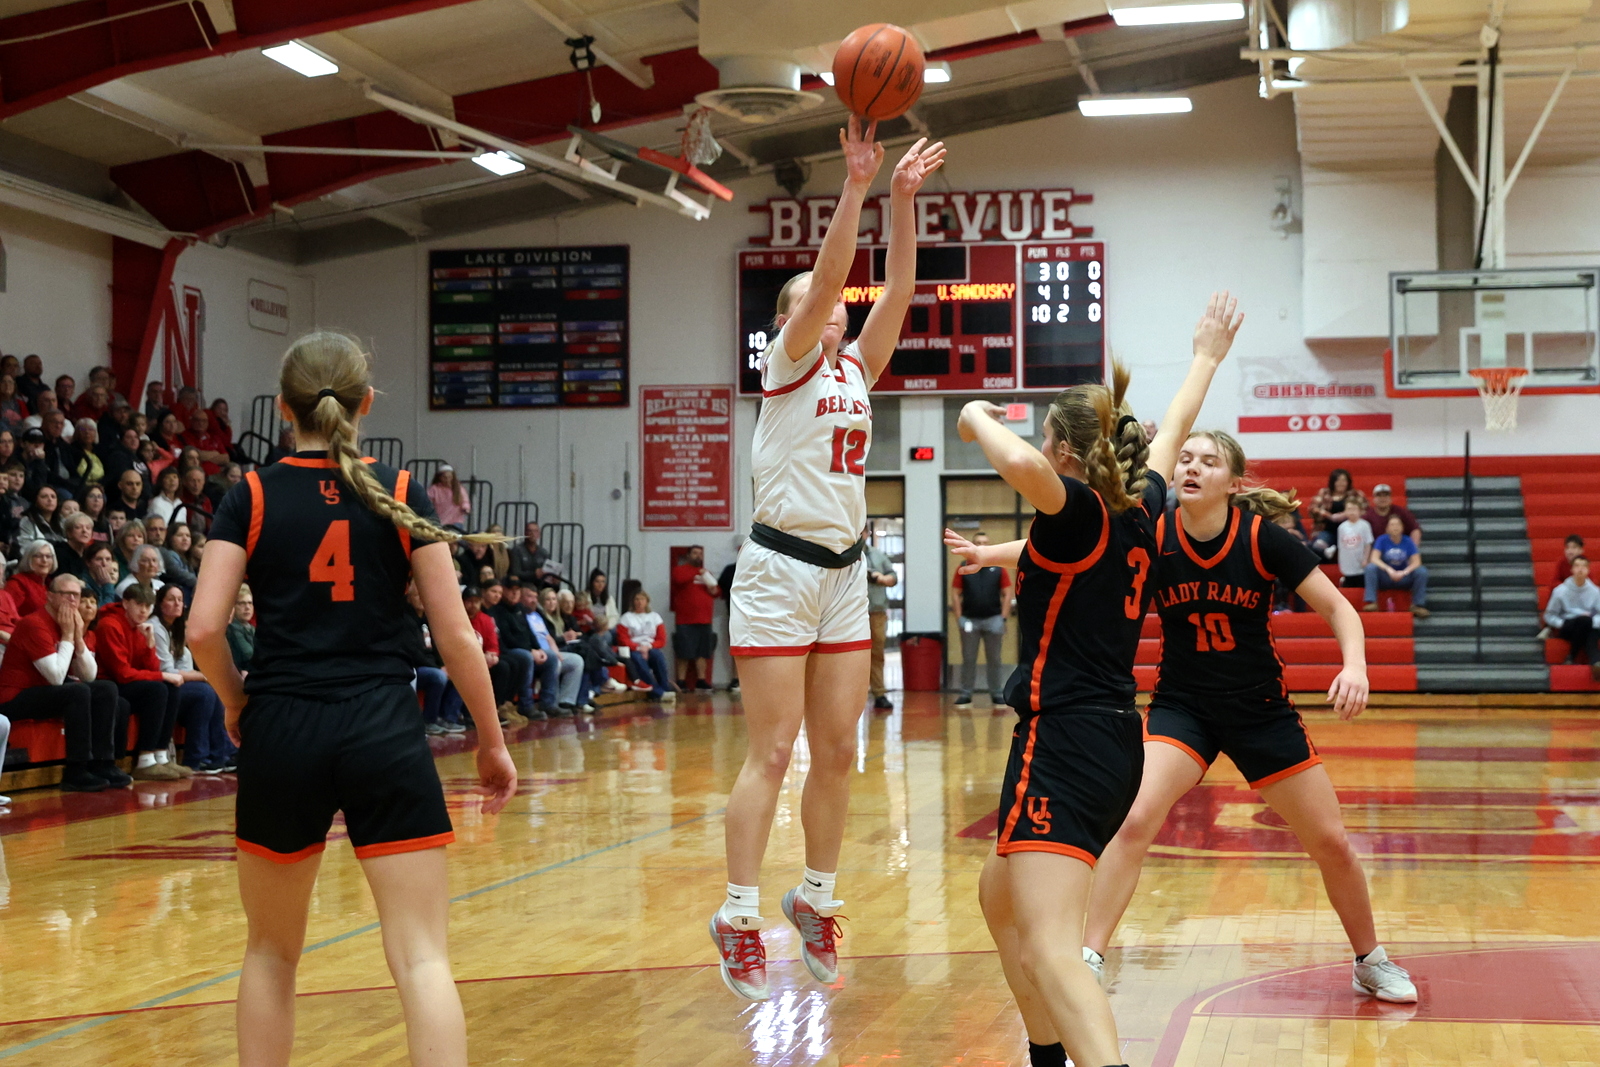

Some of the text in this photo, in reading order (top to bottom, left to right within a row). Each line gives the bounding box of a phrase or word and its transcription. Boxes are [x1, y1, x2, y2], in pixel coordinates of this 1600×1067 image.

[465, 251, 592, 265] LAKE DIVISION
[796, 253, 810, 265] PTS
[1028, 246, 1096, 258] PLYR FLS PTS
[1040, 260, 1101, 282] 3 0 0
[937, 283, 1015, 300] U.SANDUSKY
[1038, 282, 1101, 300] 4 1 9
[1032, 302, 1101, 324] 10 2 0
[749, 331, 767, 350] 10
[896, 338, 952, 350] LAYER FOUL
[983, 336, 1014, 348] FOULS
[904, 379, 937, 390] MATCH
[983, 377, 1014, 389] SCORE
[1254, 384, 1375, 398] @BHSRedmen
[646, 398, 728, 415] BELLEVUE HS
[645, 434, 728, 442] EXPECTATION
[829, 425, 867, 477] 12
[319, 480, 340, 505] US
[309, 520, 355, 602] 4
[1124, 546, 1151, 620] 3
[1158, 581, 1260, 609] LADY RAMS
[1187, 612, 1236, 652] 10
[1027, 796, 1052, 835] US
